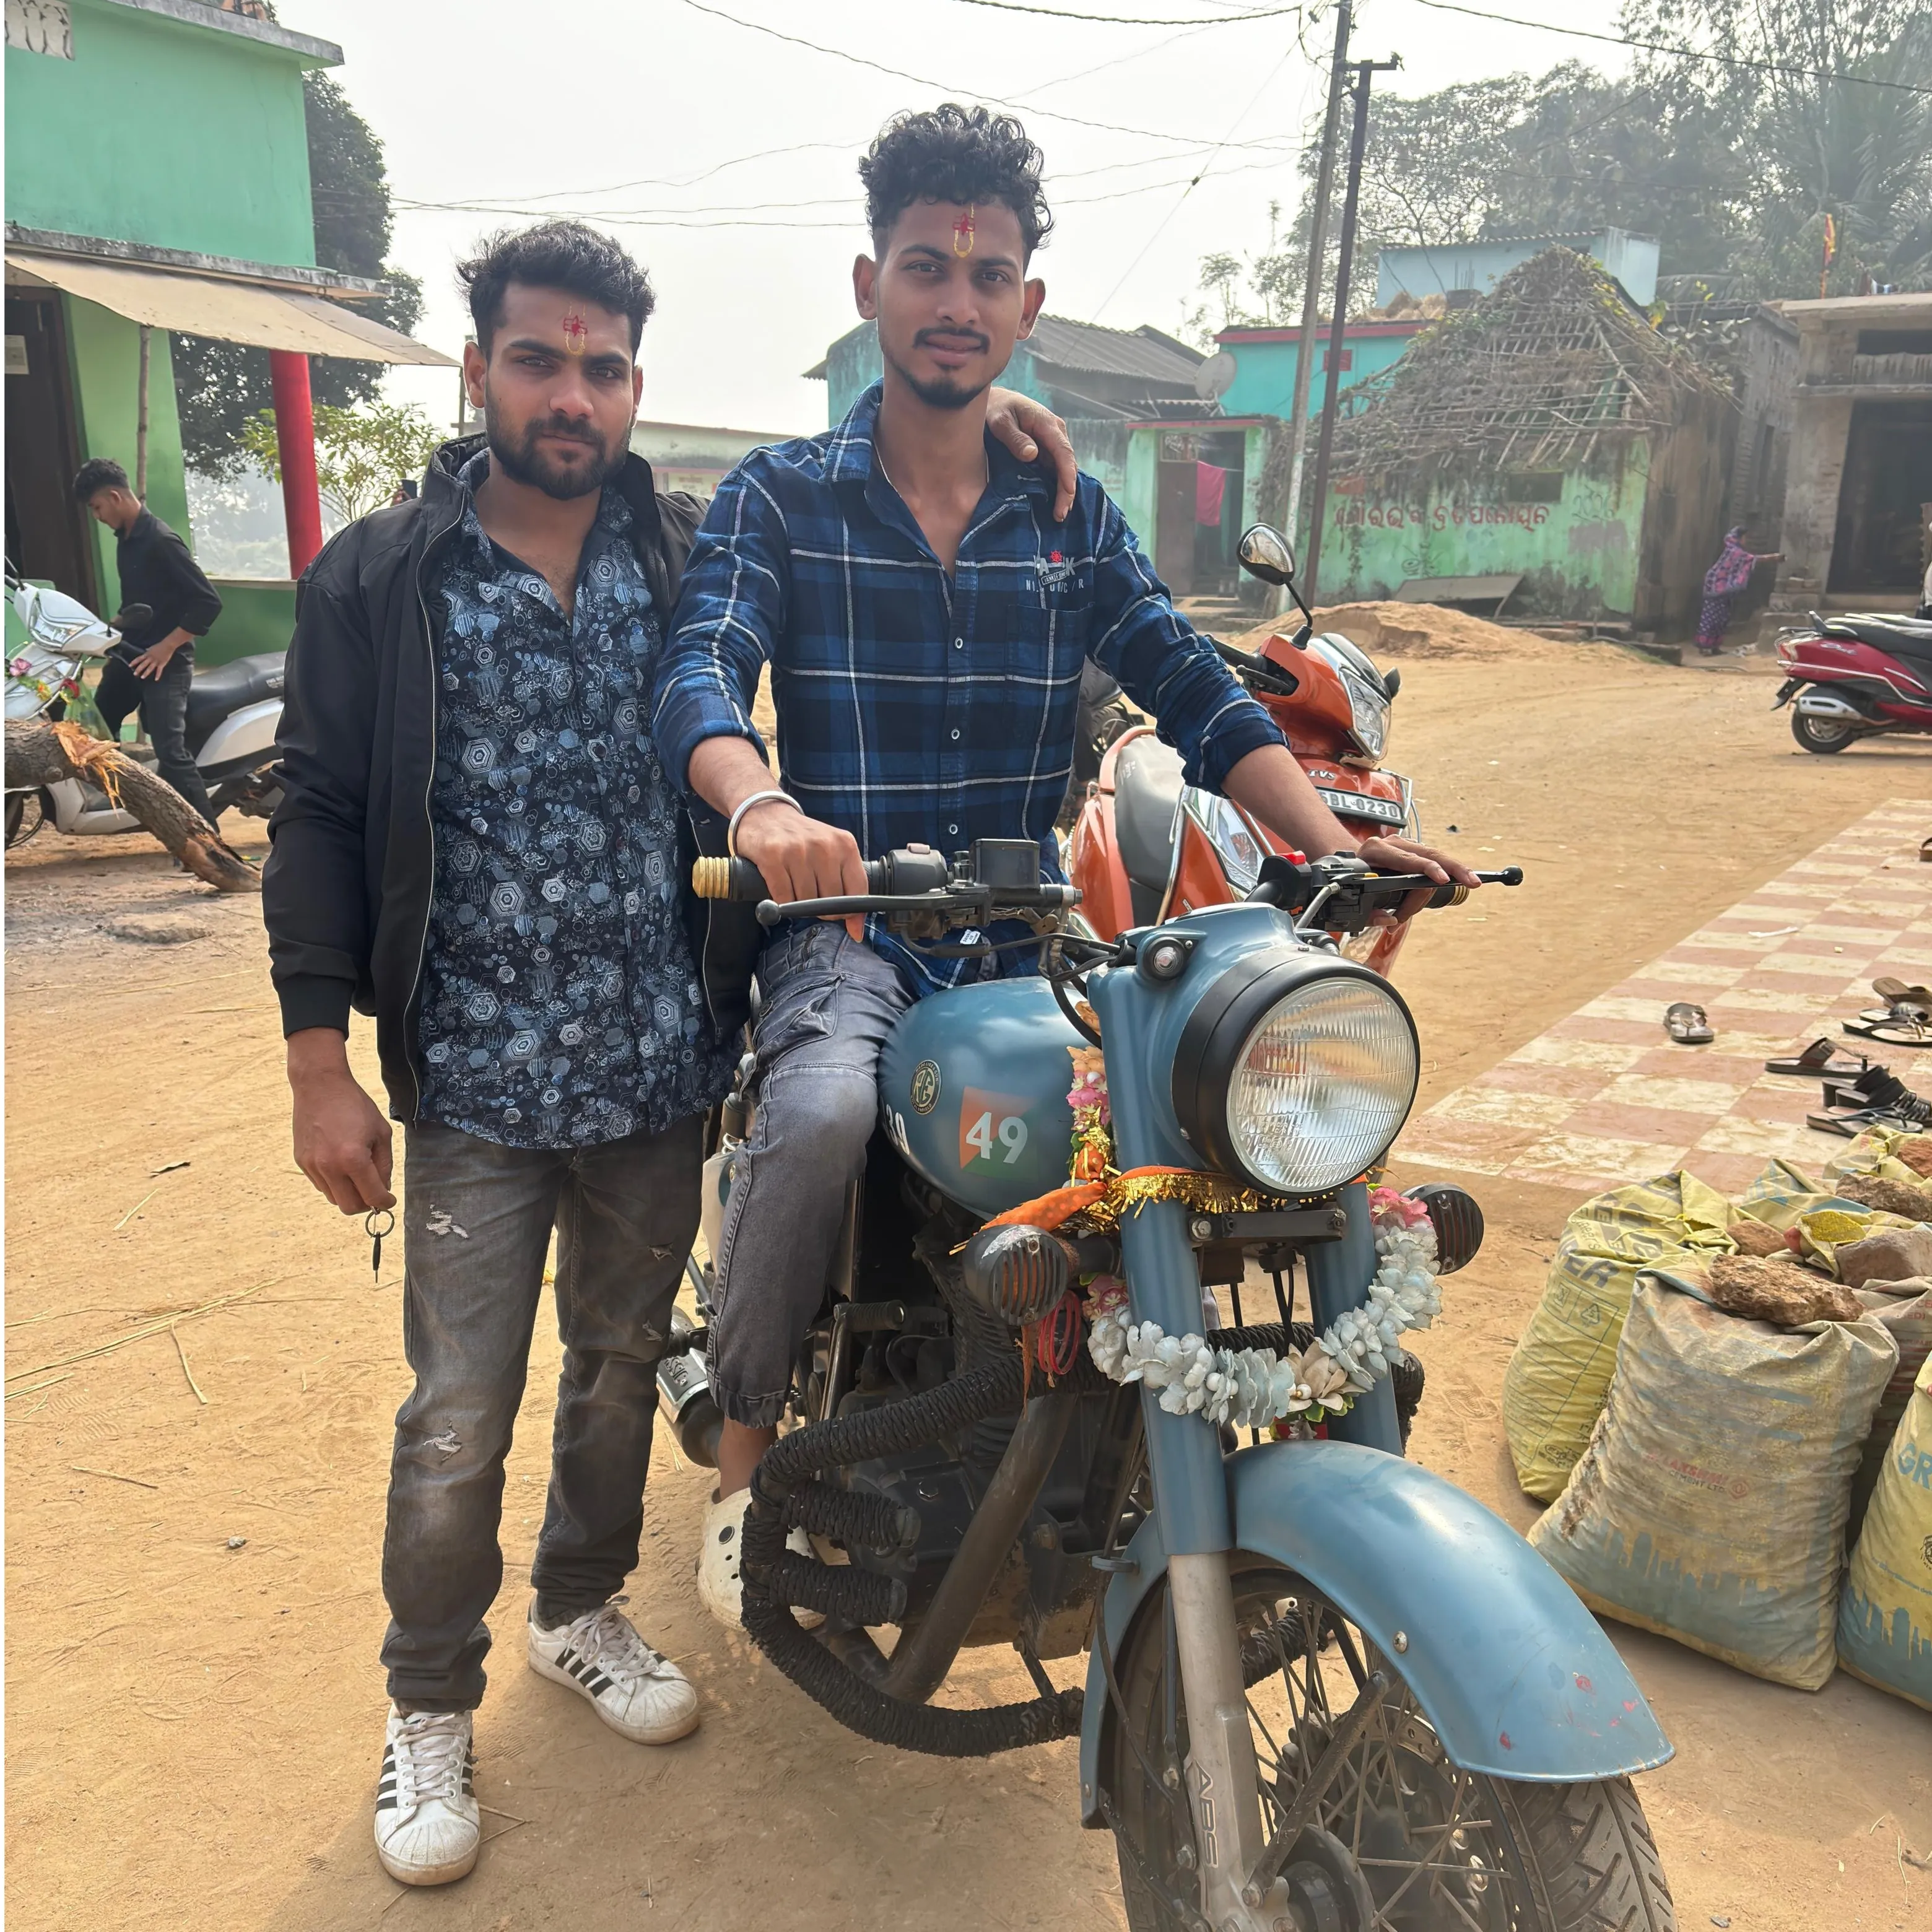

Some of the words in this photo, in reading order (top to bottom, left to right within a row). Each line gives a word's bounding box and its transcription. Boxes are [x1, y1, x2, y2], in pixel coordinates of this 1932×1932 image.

[1308, 769, 1336, 780] TVS
[966, 1112, 1028, 1164] 49
[1193, 1760, 1218, 1868] ABS
